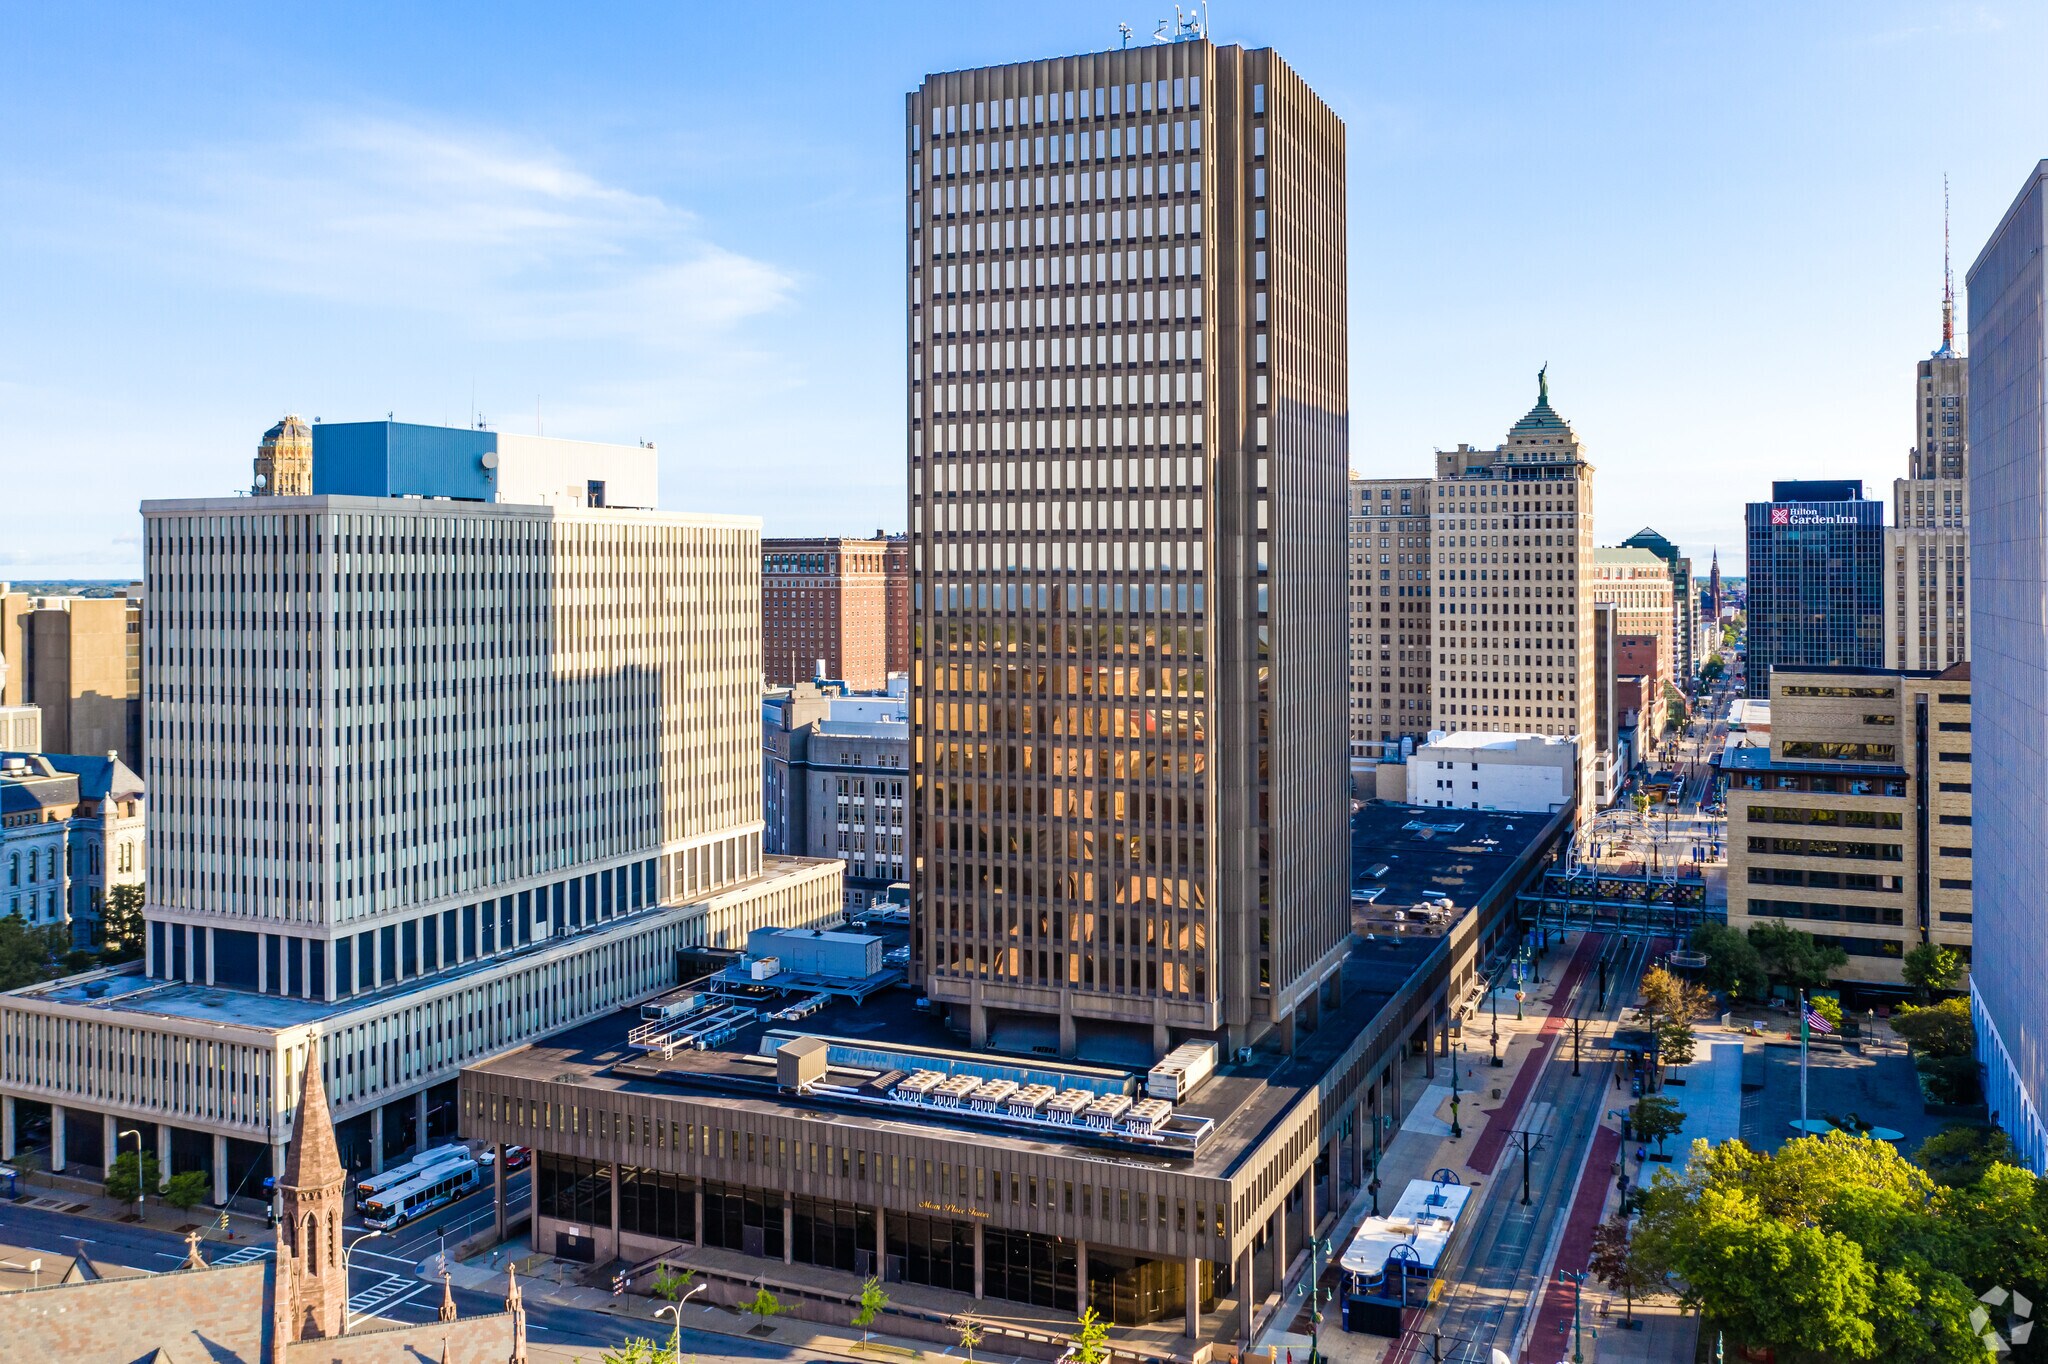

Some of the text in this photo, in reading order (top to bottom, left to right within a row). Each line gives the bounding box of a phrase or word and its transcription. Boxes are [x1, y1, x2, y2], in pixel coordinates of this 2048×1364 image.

[1790, 515, 1858, 524] Garden Inn
[919, 1201, 990, 1218] Main Place Tower
